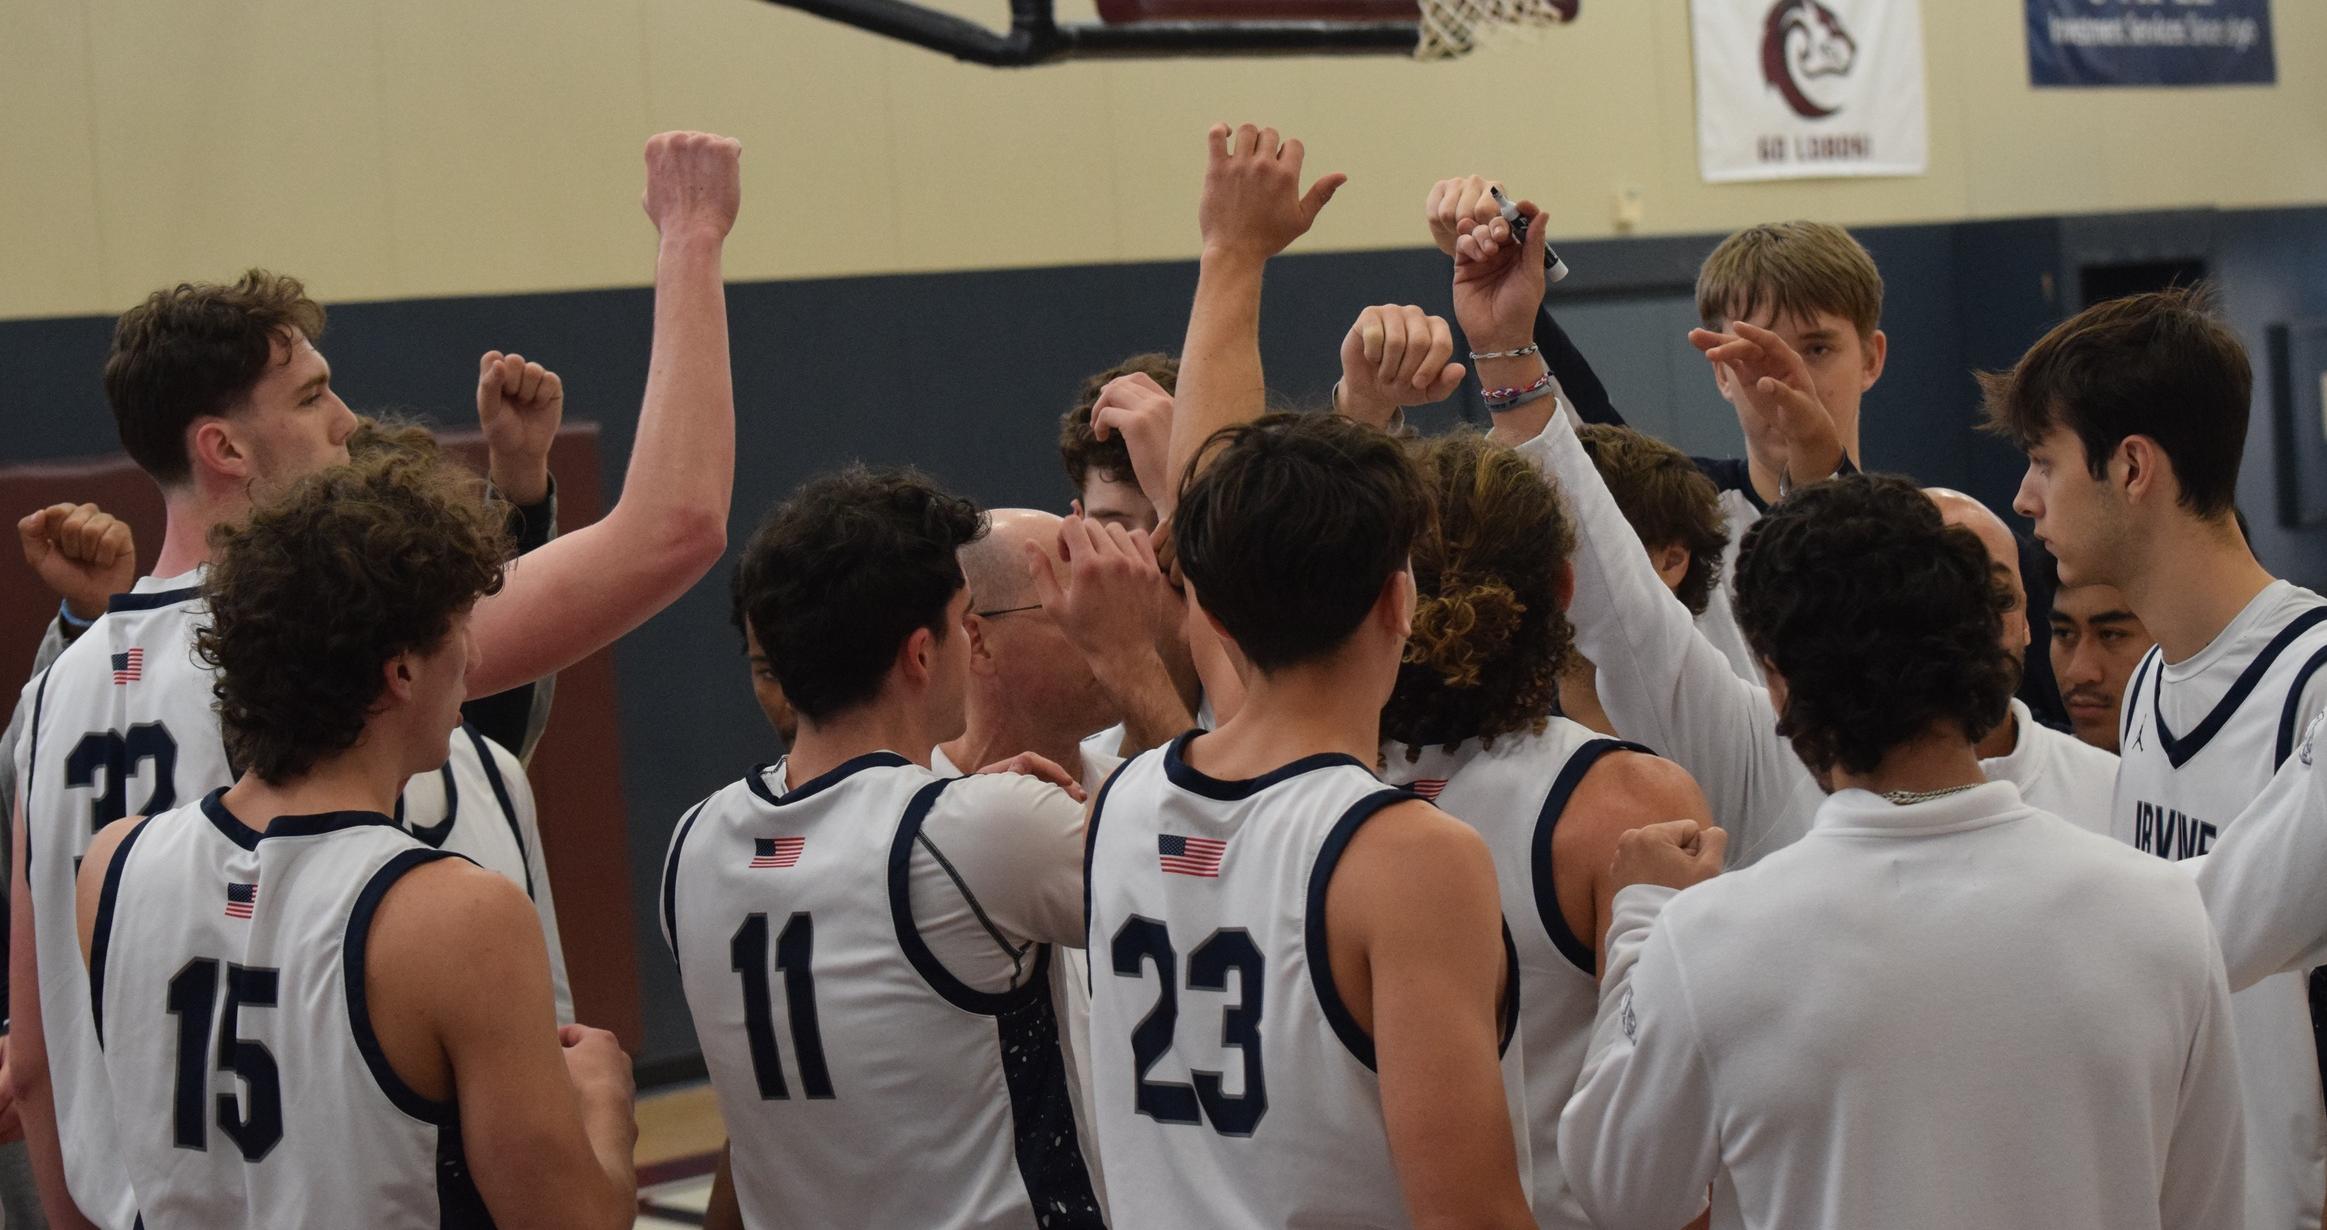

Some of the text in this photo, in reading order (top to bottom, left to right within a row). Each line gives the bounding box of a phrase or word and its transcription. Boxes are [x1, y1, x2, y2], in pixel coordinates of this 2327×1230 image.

[1757, 134, 1786, 162] GO
[166, 956, 284, 1163] 15
[730, 911, 836, 1100] 11
[1111, 914, 1268, 1137] 23
